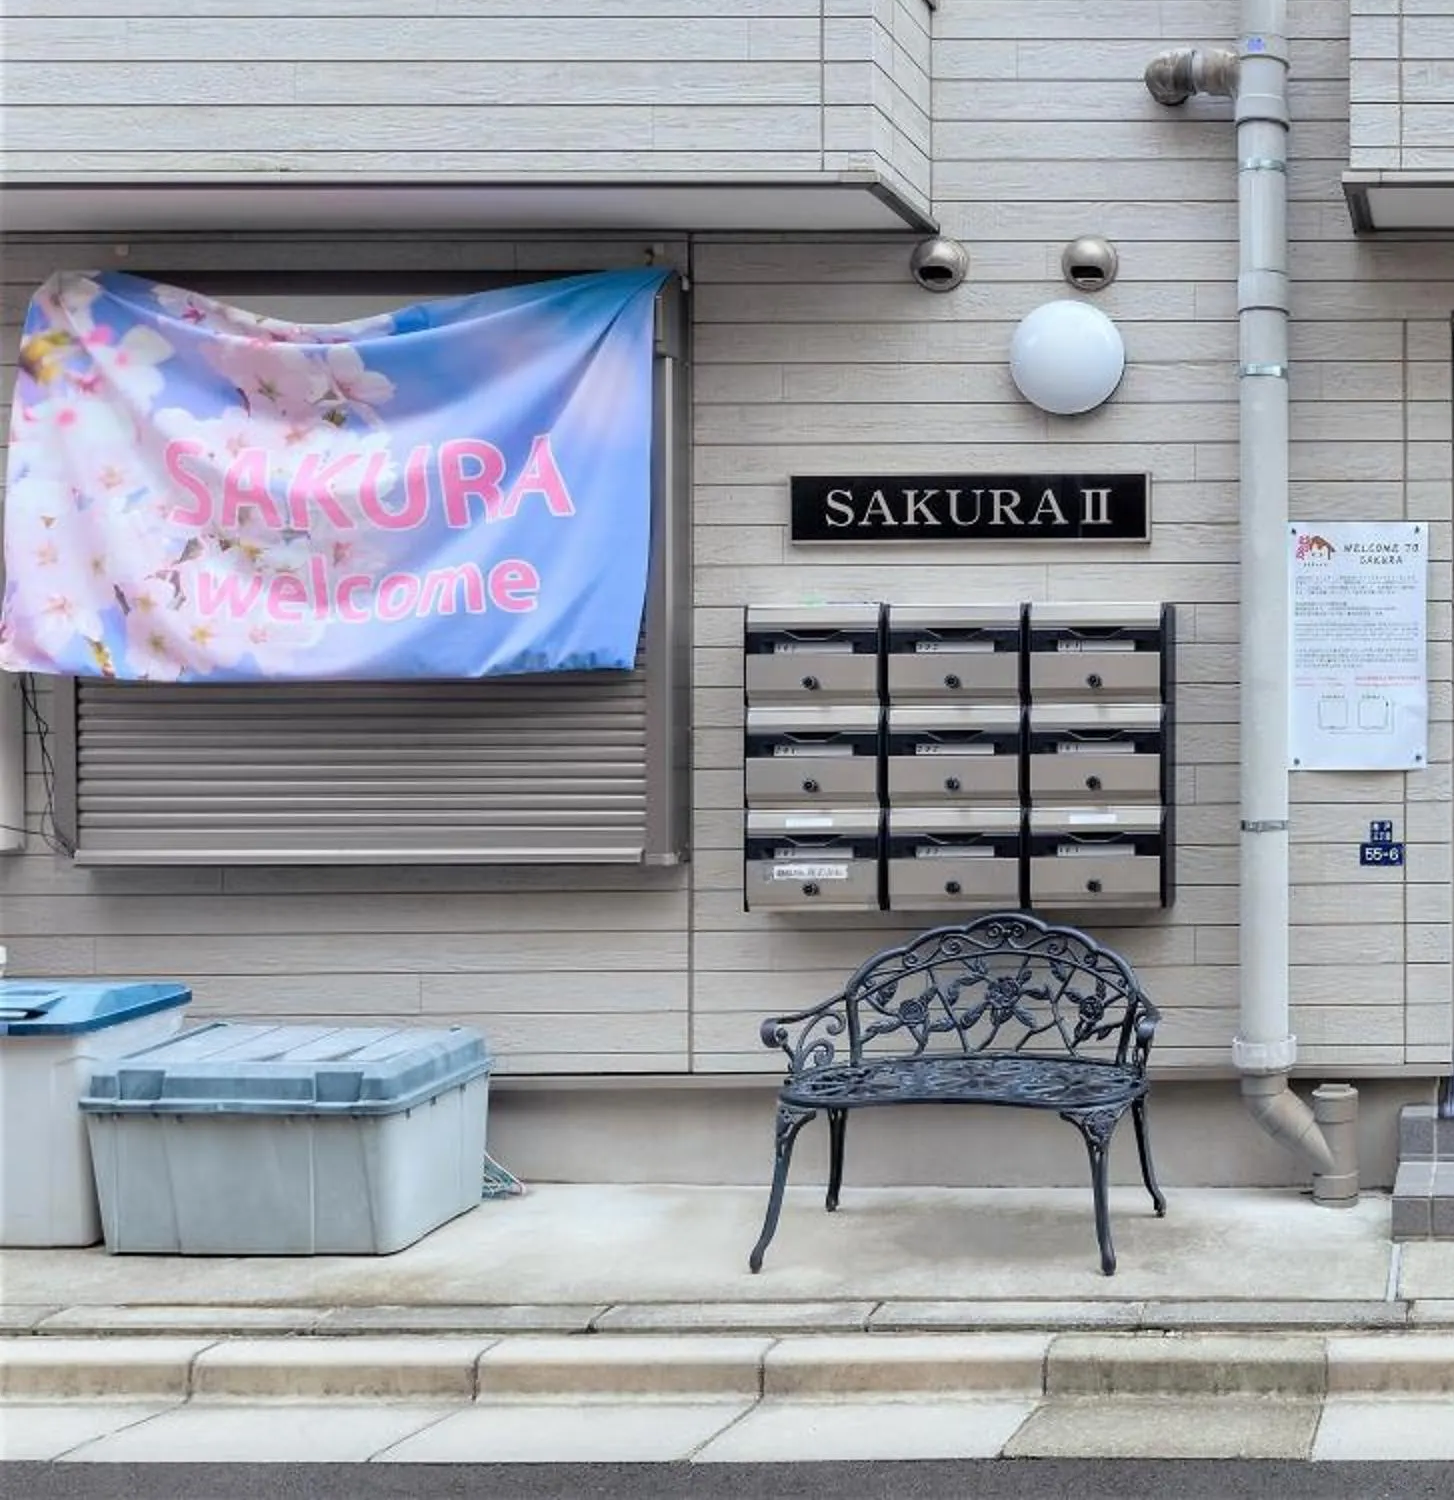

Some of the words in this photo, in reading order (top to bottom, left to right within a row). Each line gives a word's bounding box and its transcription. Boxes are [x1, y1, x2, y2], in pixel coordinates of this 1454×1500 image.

[162, 434, 577, 530] SAKURA
[825, 488, 1069, 527] SAKURA
[192, 557, 540, 623] welcome
